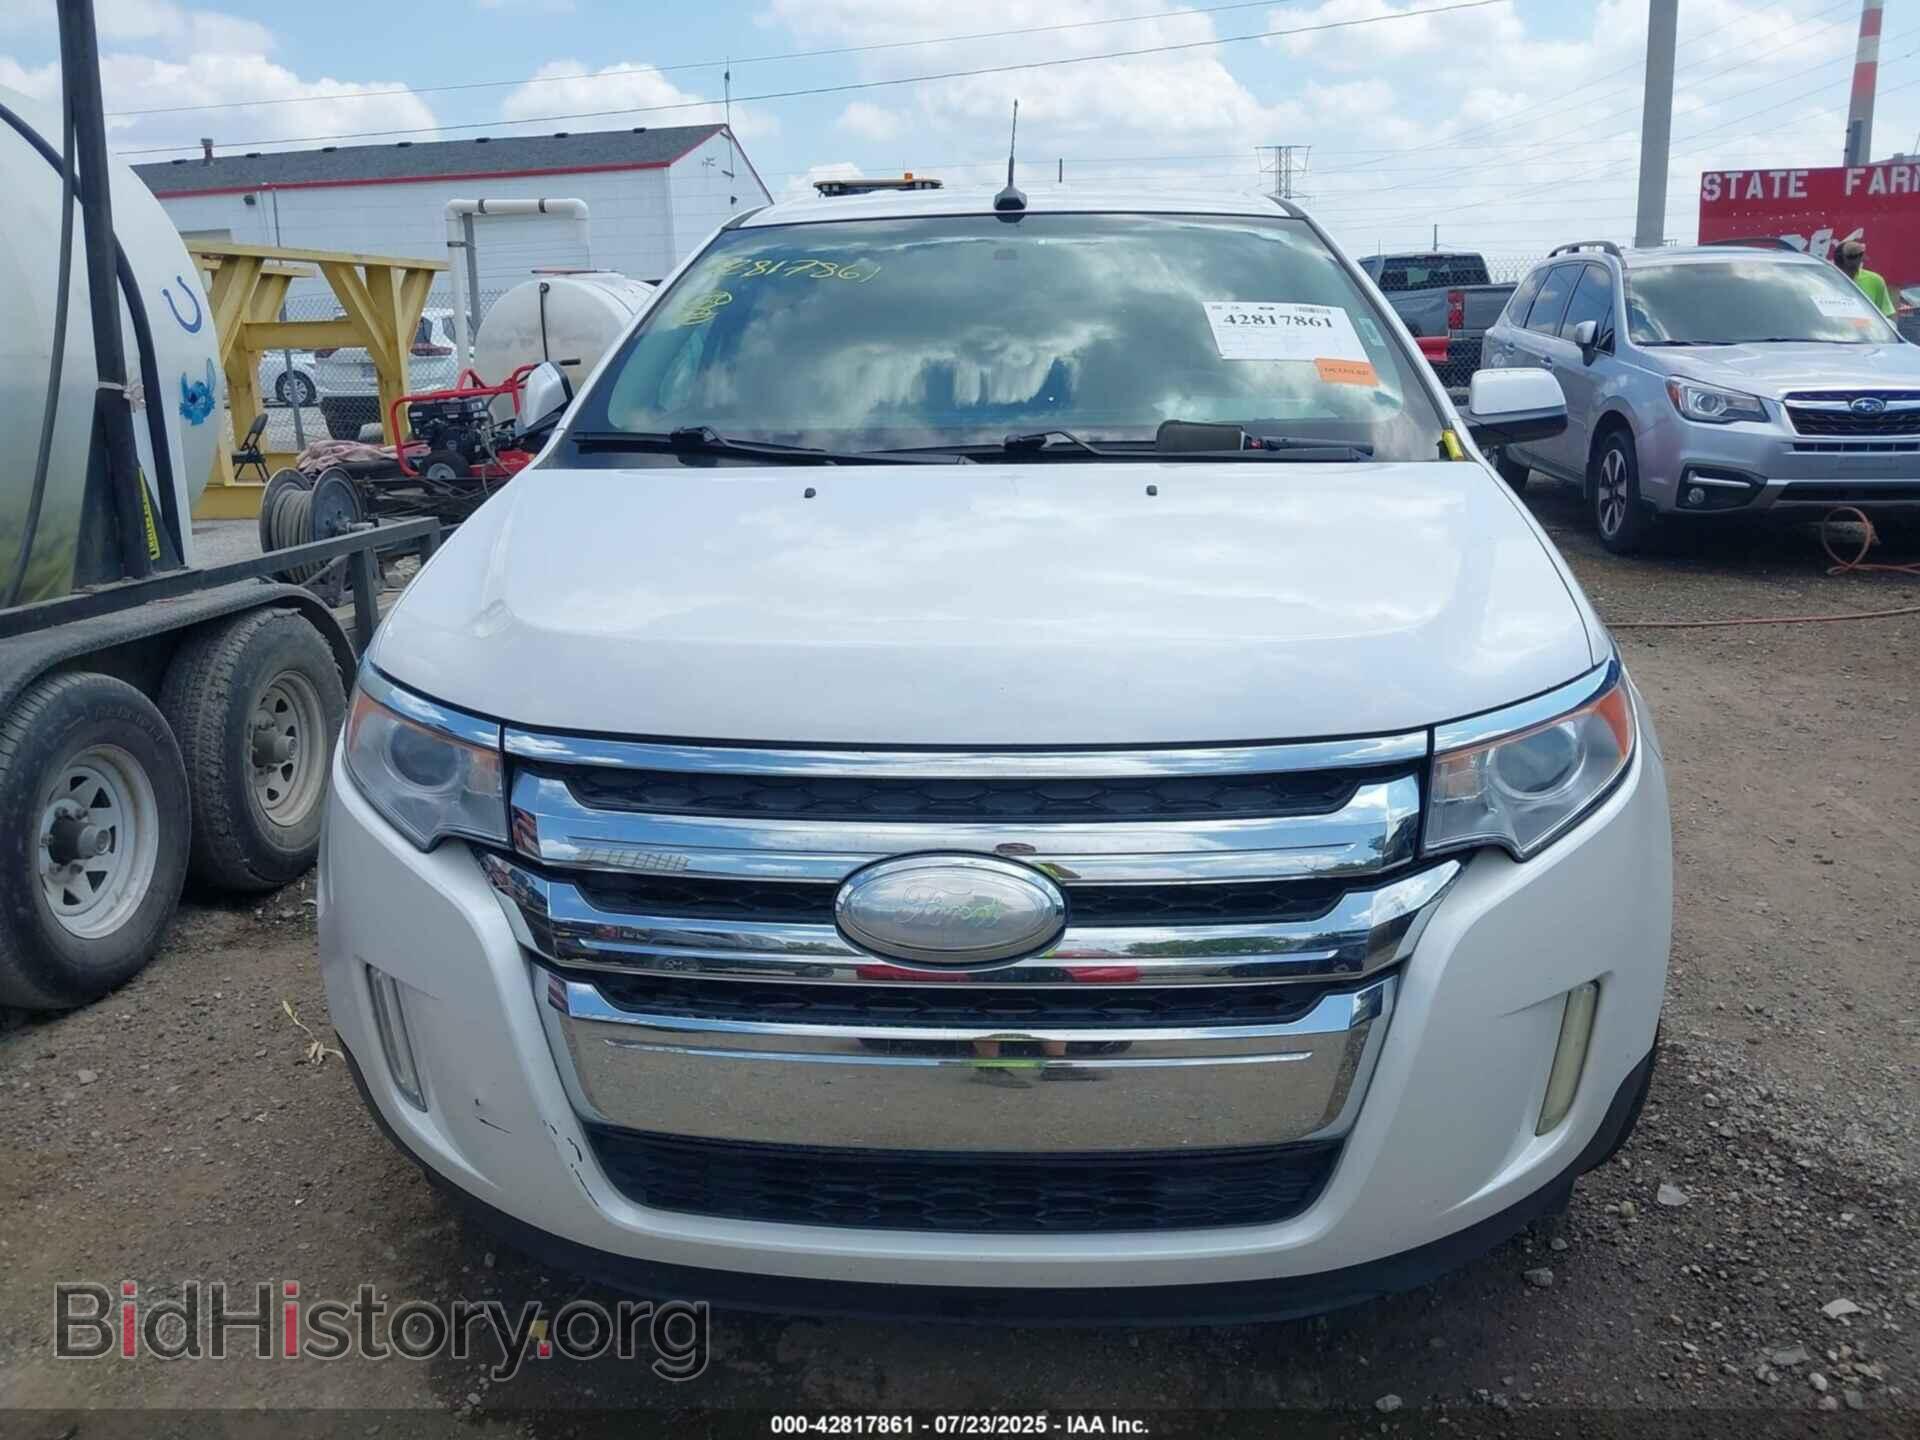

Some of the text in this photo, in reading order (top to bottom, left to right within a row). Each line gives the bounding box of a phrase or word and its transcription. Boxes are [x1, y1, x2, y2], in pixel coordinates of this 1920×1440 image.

[1702, 170, 1808, 201] STATE
[1223, 313, 1333, 328] 42817861
[896, 883, 1003, 928] Ford
